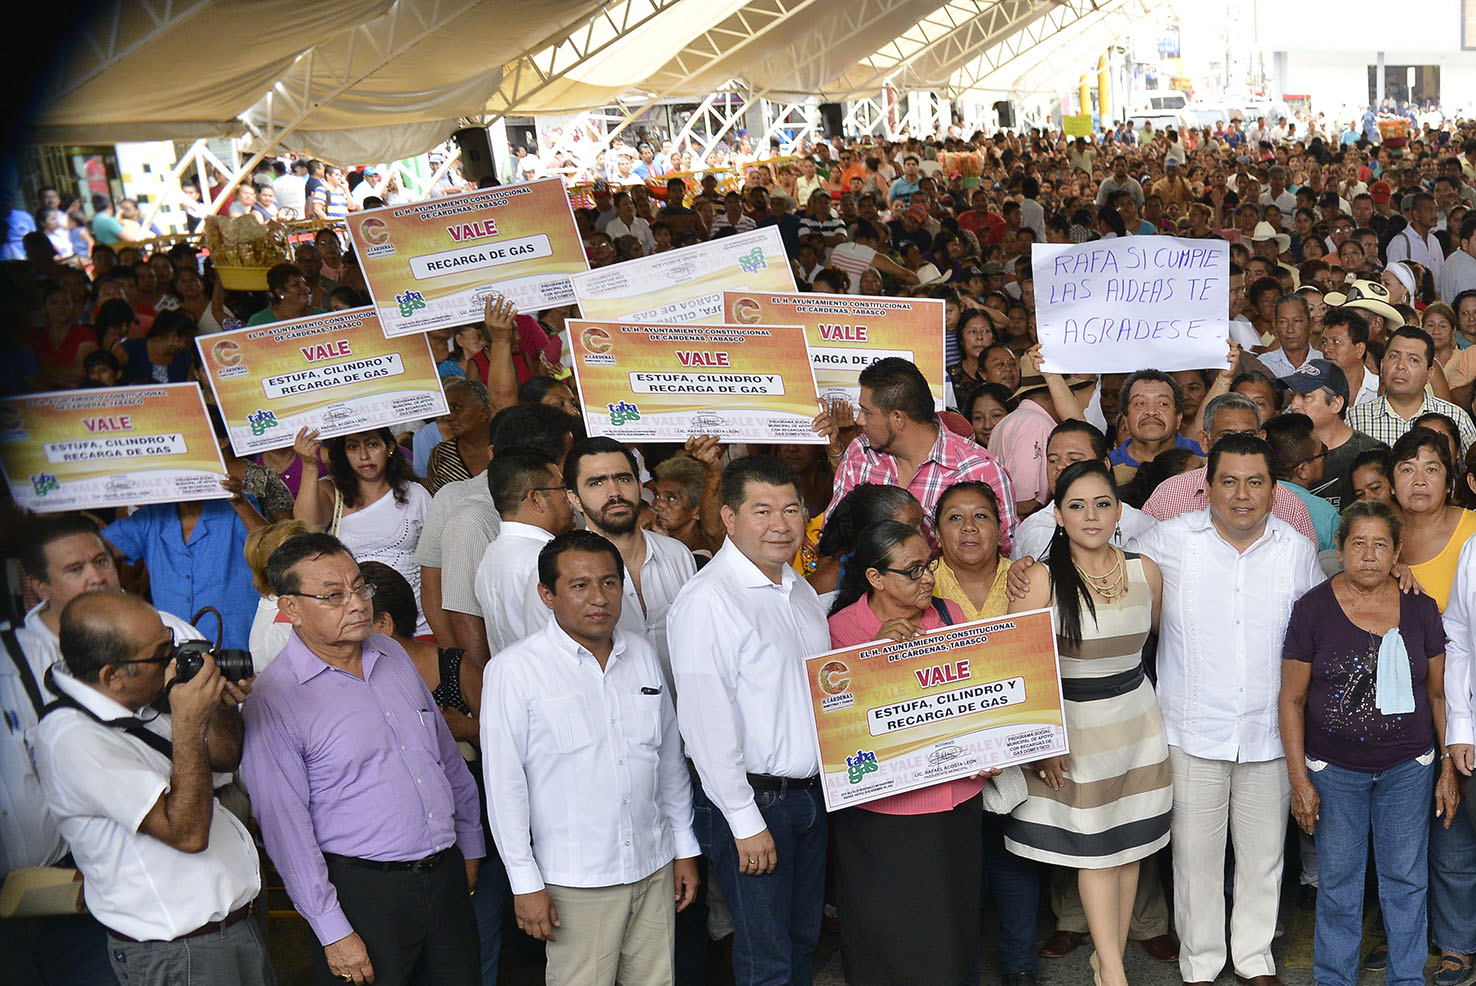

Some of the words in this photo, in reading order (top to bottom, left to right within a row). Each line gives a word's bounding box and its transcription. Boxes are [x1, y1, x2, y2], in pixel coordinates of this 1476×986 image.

[414, 198, 469, 214] AYUNTAMIENTO
[470, 187, 531, 203] CONSTITUCIONAL
[432, 205, 475, 218] CÁRDENAS,
[475, 199, 508, 212] TABASCO
[447, 219, 498, 242] VALE
[427, 253, 487, 271] RECARGA
[490, 248, 507, 259] DE
[510, 243, 535, 256] GAS
[738, 247, 765, 266] gas
[1054, 249, 1119, 276] RAFA
[1125, 246, 1147, 270] SI
[742, 260, 767, 274] taba
[395, 290, 424, 302] taba
[1050, 278, 1091, 304] LAS
[1187, 277, 1219, 301] TE
[399, 298, 426, 317] gas
[792, 299, 848, 307] AYUNTAMIENTO
[849, 301, 912, 310] CONSTITUCIONAL
[808, 305, 851, 315] CÁRDENAS,
[268, 320, 324, 336] AYUNTAMIENTO
[285, 327, 328, 341] CÁRDENAS,
[328, 321, 362, 333] TABASCO
[643, 327, 704, 335] AYUNTAMIENTO
[704, 328, 771, 337] CONSTITUCIONAL
[819, 324, 867, 341] VALE
[1063, 317, 1206, 344] AGRADESE
[662, 333, 708, 342] CÁRDENAS,
[301, 340, 351, 361] VALE
[676, 351, 729, 366] VALE
[811, 354, 848, 364] ARGA
[852, 355, 868, 365] DE
[268, 370, 321, 386] ESTUFA,
[323, 359, 383, 376] CILINDRO
[385, 355, 394, 364] Y
[636, 373, 694, 383] ESTUFA,
[697, 374, 761, 384] CILINDRO
[764, 375, 775, 384] Y
[281, 378, 342, 395] RECARGA
[344, 373, 360, 384] DE
[364, 368, 389, 379] GAS
[648, 383, 714, 393] RECARGA
[719, 384, 737, 393] DE
[740, 385, 768, 394] GAS
[608, 401, 639, 413] taba
[82, 417, 132, 432] VALE
[247, 410, 274, 423] taba
[609, 410, 641, 426] gas
[250, 418, 278, 436] gas
[50, 441, 103, 452] ESTUFA,
[105, 436, 164, 448] CILINDRO
[168, 435, 177, 443] Y
[63, 449, 123, 461] RECARGA
[125, 447, 141, 456] DE
[146, 446, 172, 454] GAS
[859, 651, 871, 659] EL
[871, 648, 881, 657] H.
[881, 634, 945, 655] AYUNTAMIENTO
[945, 621, 1016, 642] CONSTITUCIONAL
[888, 653, 900, 662] DE
[900, 642, 949, 660] CÁRDENAS,
[950, 635, 988, 649] TABASCO
[915, 661, 971, 688] VALE
[875, 696, 933, 720] ESTUFA,
[936, 683, 1004, 705] CILINDRO
[1006, 680, 1017, 690] Y
[887, 708, 954, 730] RECARGA
[958, 702, 976, 715] DE
[980, 695, 1009, 710] GAS
[1006, 738, 1030, 747] MUNICIPAL
[1038, 733, 1054, 741] APOYO
[1008, 732, 1034, 742] PROGRAMA
[1034, 728, 1051, 737] SOCIAL
[1020, 740, 1045, 750] RECARGAS
[1023, 744, 1050, 754] DOMÉSTICO
[846, 750, 875, 767] taba
[924, 767, 943, 775] RAFAEL
[943, 762, 963, 772] ACOSTA
[963, 758, 977, 766] LEÓN
[847, 759, 878, 785] gas
